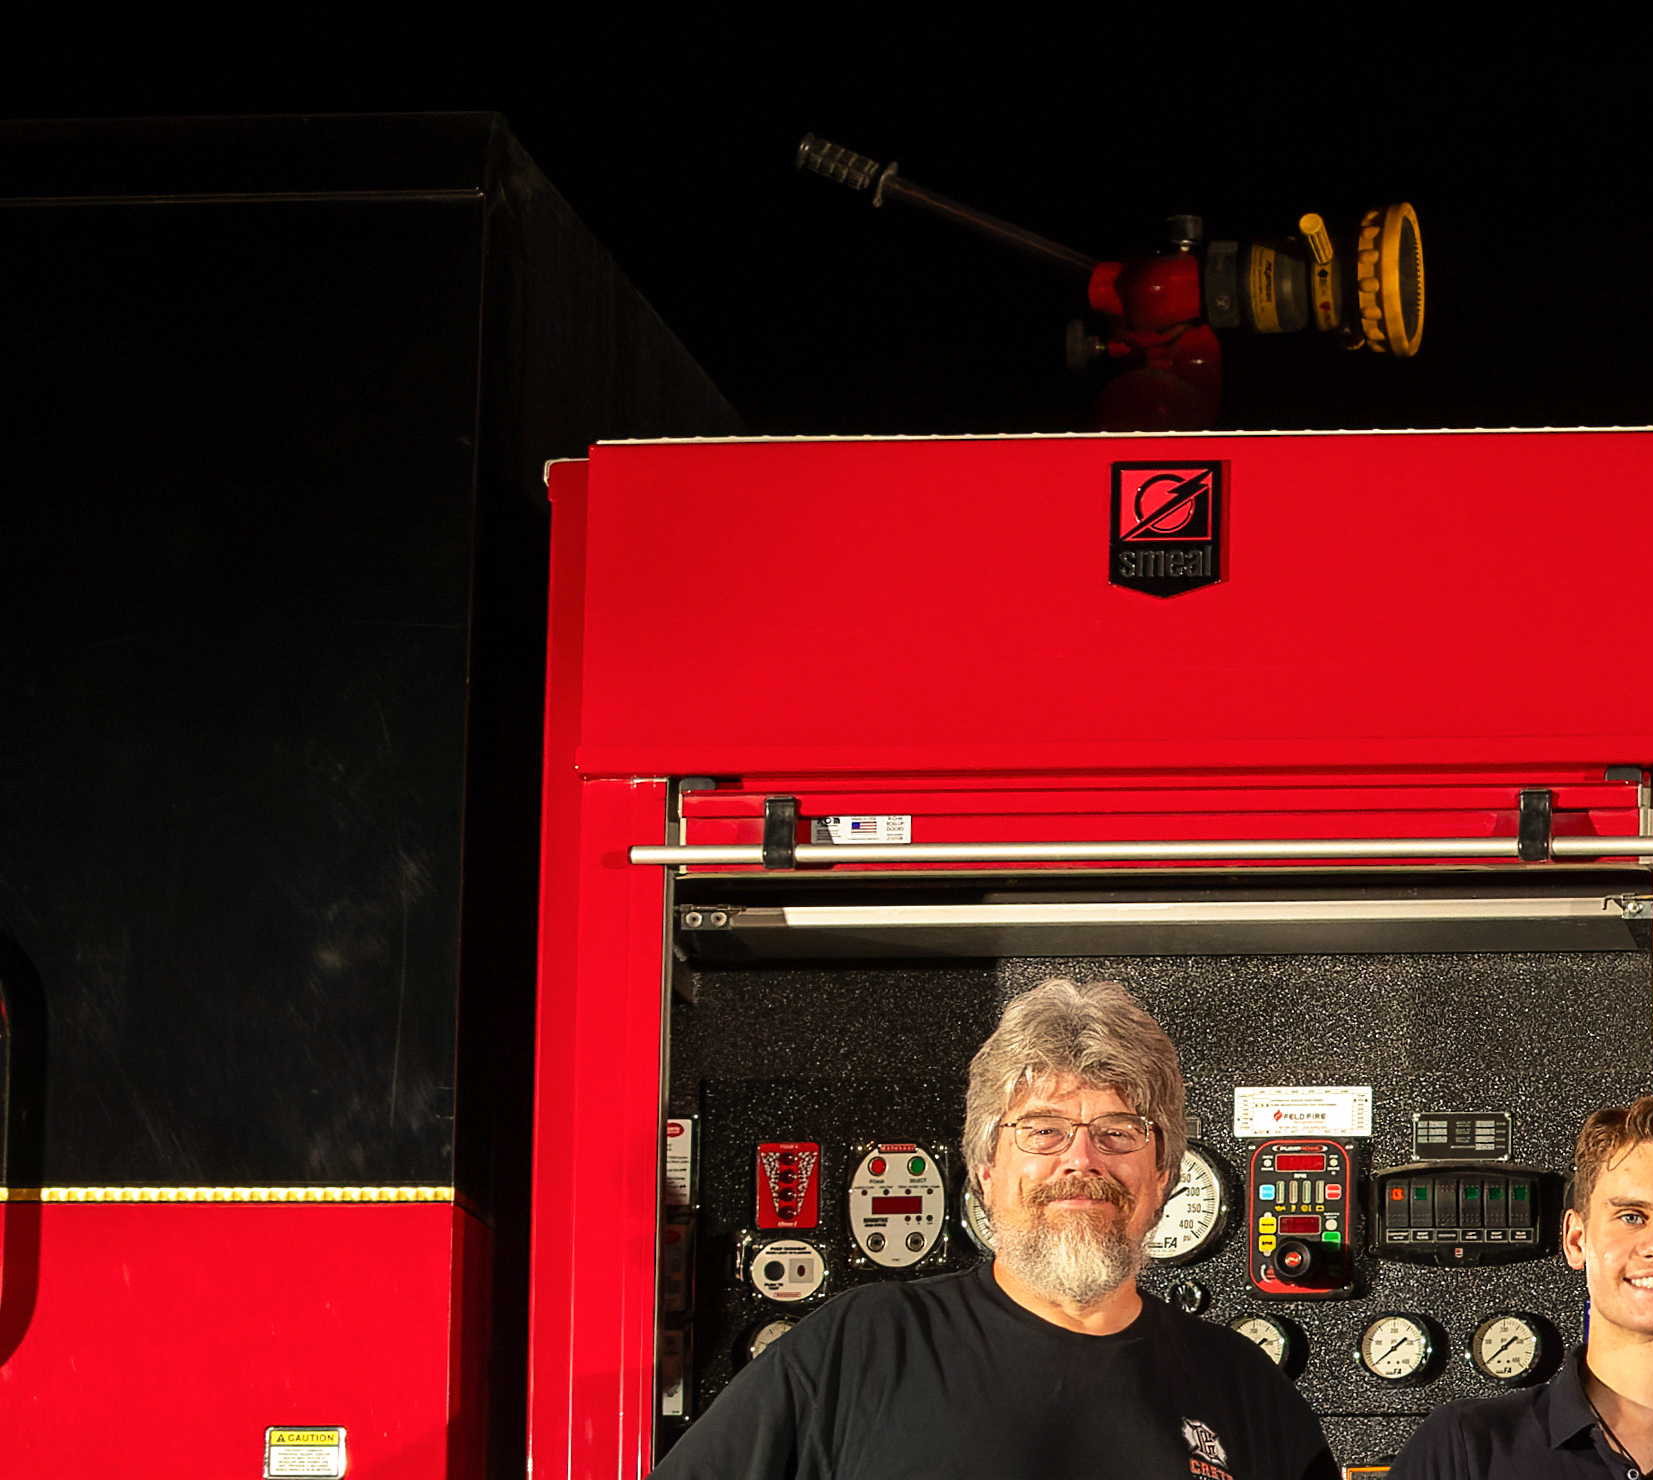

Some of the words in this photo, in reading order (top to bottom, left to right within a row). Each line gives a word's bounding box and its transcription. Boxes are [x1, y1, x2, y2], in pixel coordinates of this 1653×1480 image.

[1118, 545, 1213, 578] smeal
[1186, 1186, 1200, 1197] 300
[1187, 1203, 1202, 1213] 350
[1179, 1219, 1194, 1229] 400
[288, 1434, 334, 1442] CAUTION
